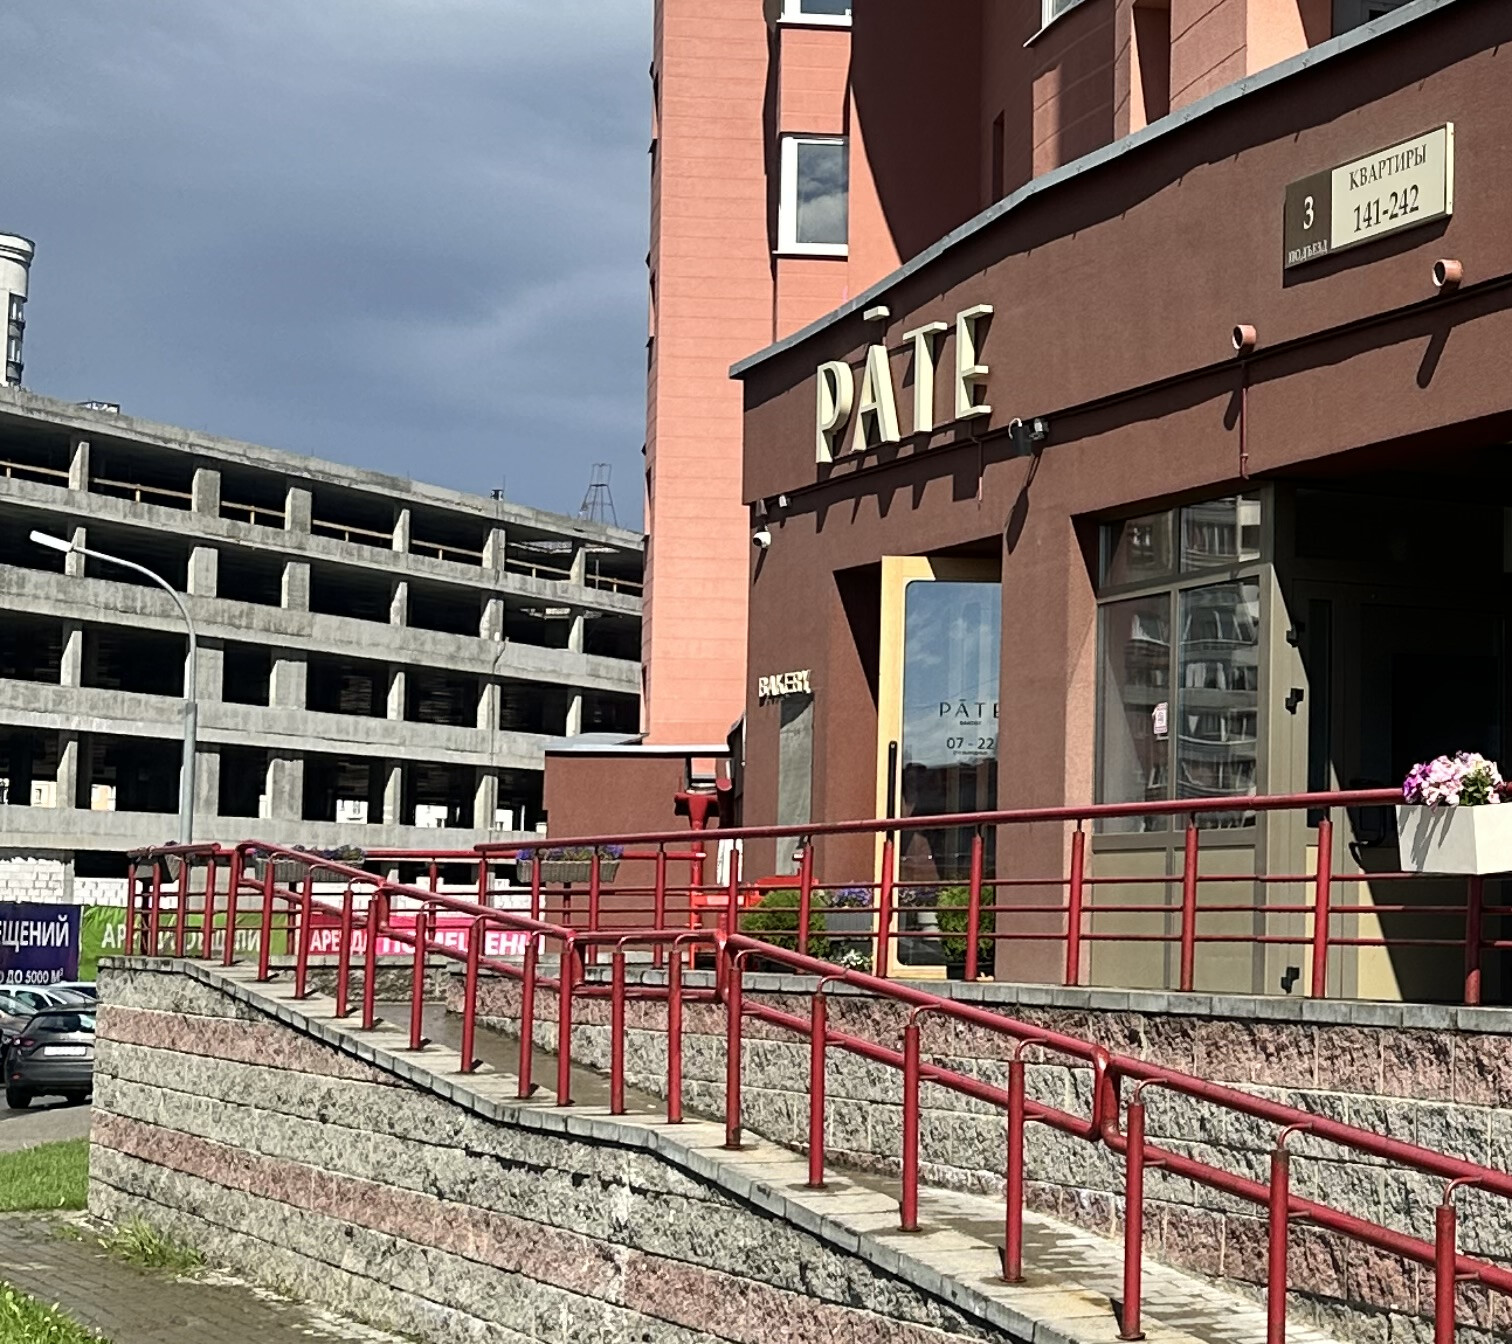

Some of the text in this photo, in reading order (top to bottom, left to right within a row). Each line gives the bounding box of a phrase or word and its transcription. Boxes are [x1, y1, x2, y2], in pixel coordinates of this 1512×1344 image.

[1349, 143, 1427, 191] КВАРТИРЫ
[1303, 196, 1314, 230] 3
[1353, 184, 1419, 233] 141-242
[758, 669, 811, 697] BAKERY
[946, 737, 964, 749] 07
[978, 737, 994, 749] 22
[6, 969, 23, 984] ДО
[25, 969, 49, 984] 5000
